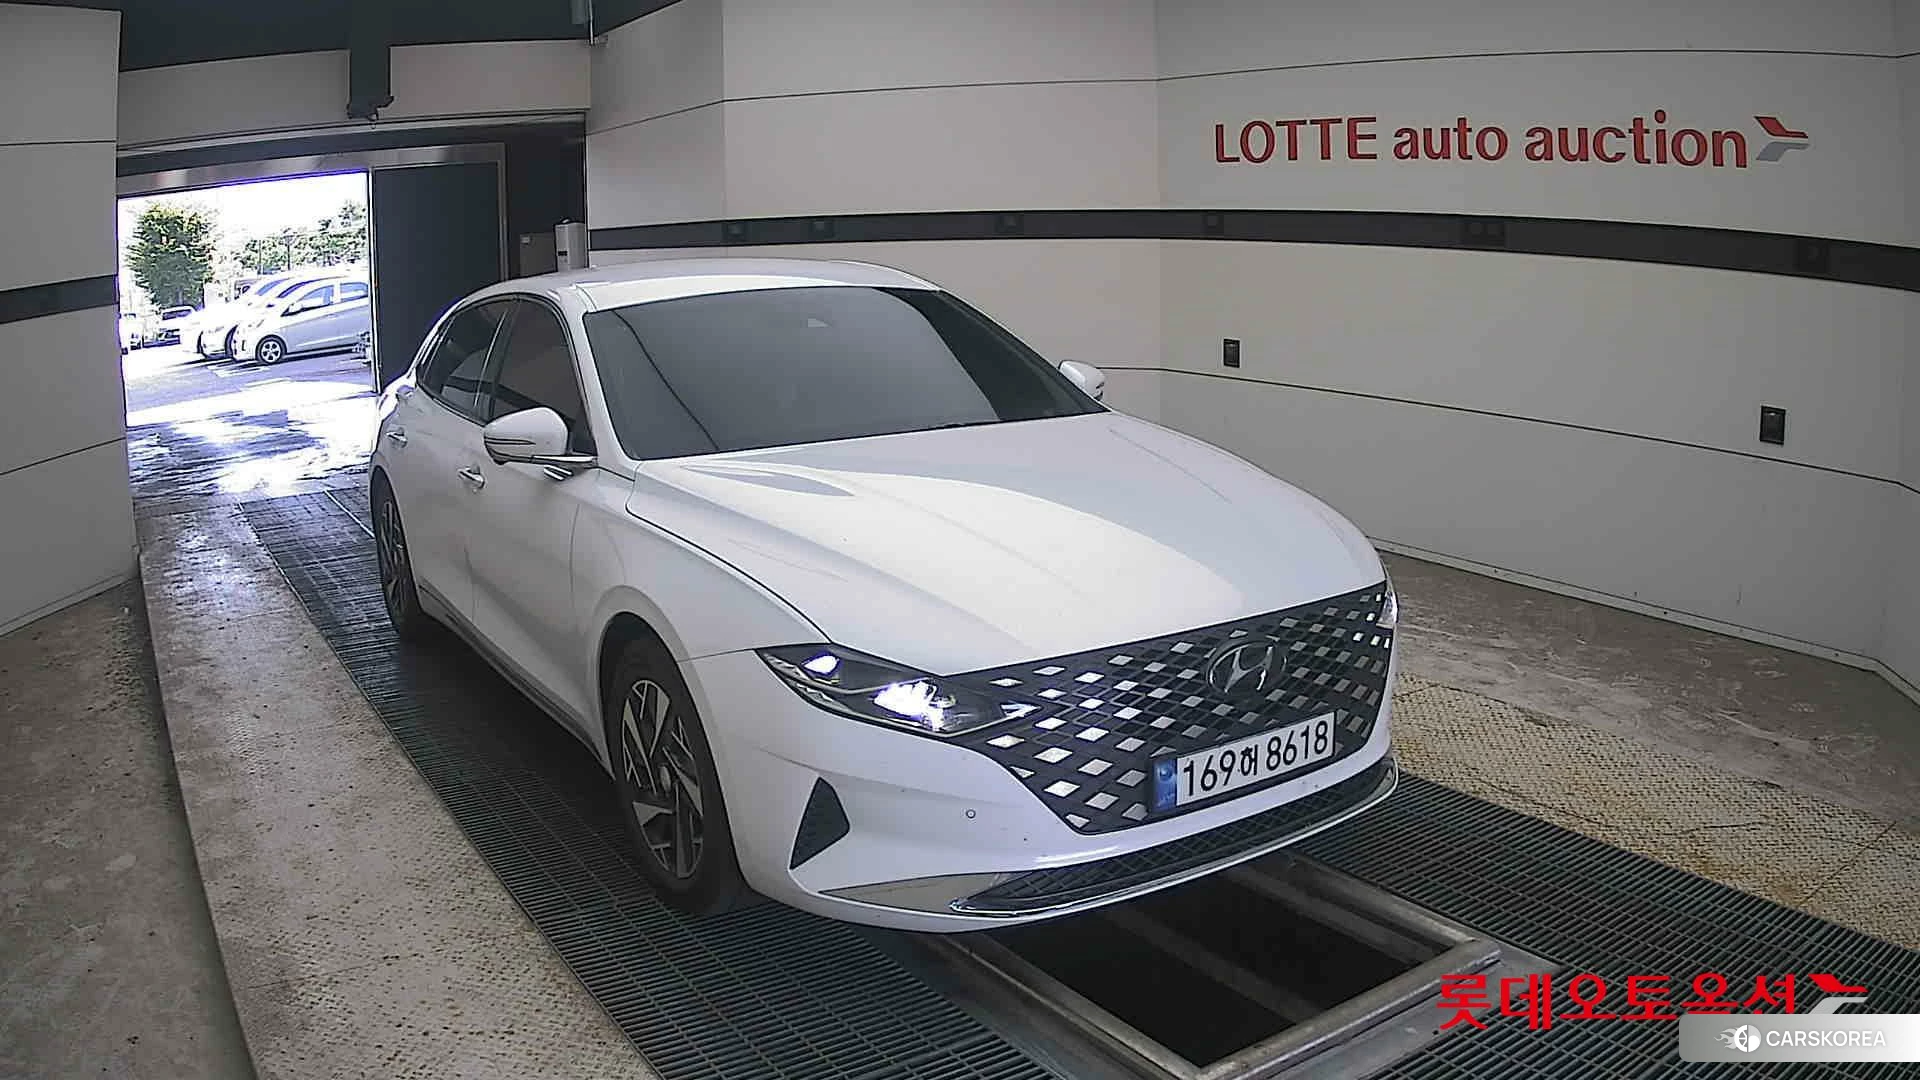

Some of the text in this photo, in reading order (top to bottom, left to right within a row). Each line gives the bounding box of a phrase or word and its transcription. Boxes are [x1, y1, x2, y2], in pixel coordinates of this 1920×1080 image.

[1215, 110, 1748, 168] LOTTE auto auction
[1266, 720, 1329, 771] 8618
